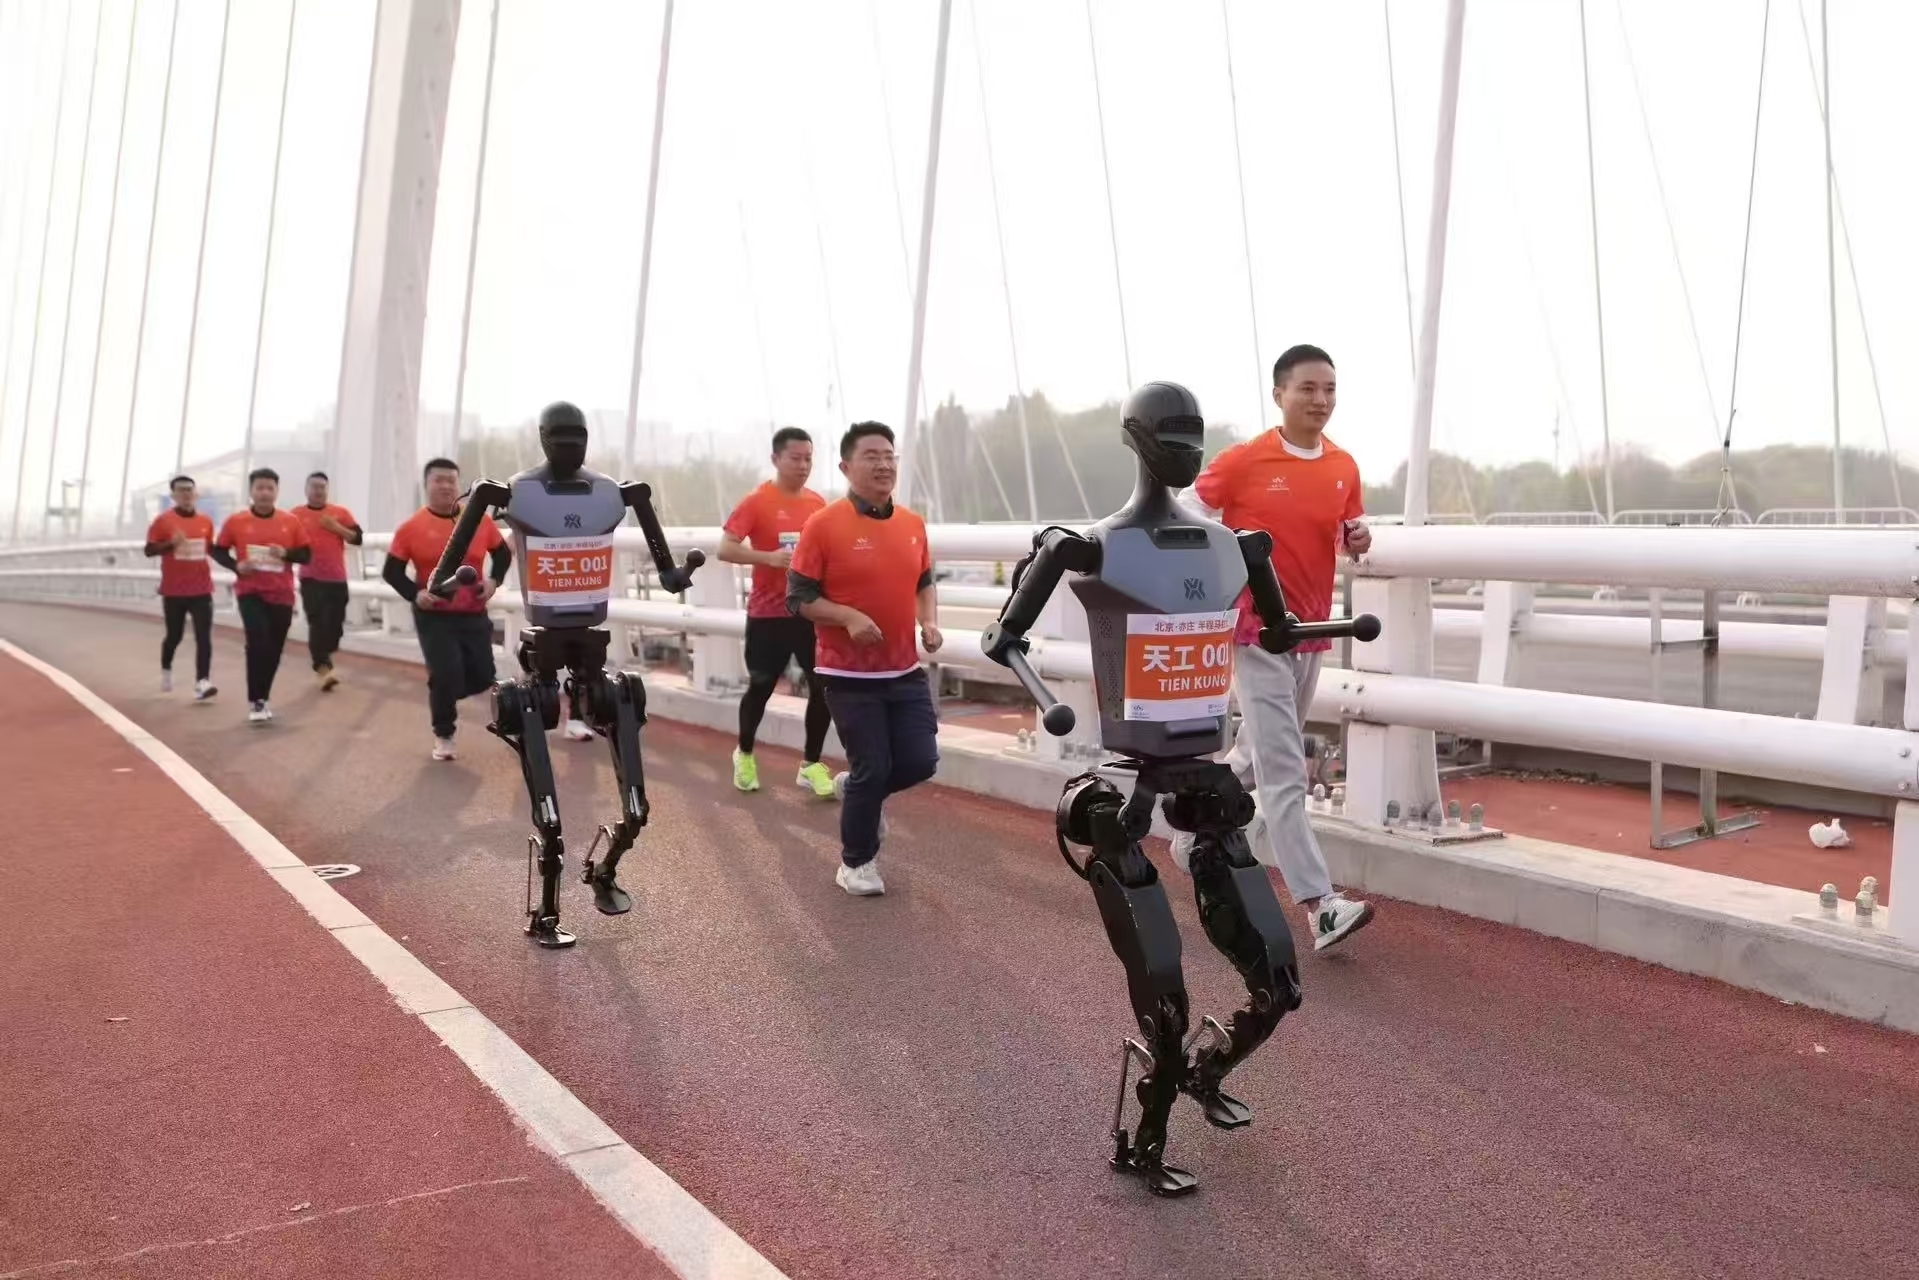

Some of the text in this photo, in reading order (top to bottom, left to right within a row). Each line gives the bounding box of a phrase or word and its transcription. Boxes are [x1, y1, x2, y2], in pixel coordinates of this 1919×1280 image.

[537, 555, 608, 575] 天工 001
[547, 575, 602, 588] TIEN KUNG
[1142, 642, 1229, 673] 天工 001
[1158, 673, 1226, 692] TIEN KUNG
